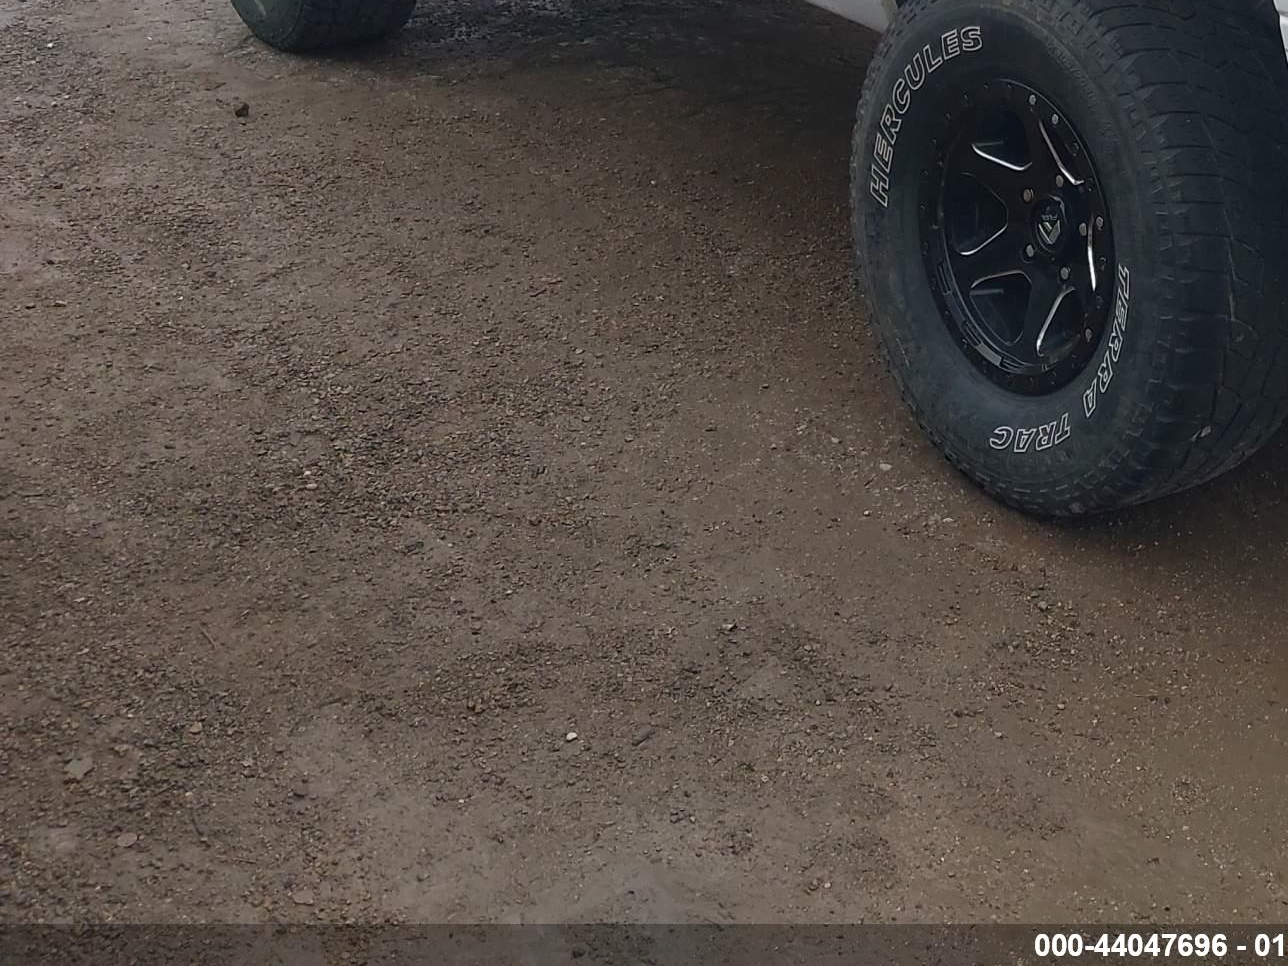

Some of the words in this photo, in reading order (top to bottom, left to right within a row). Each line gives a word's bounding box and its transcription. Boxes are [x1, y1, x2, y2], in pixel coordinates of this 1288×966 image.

[870, 26, 983, 207] HERCULES
[1083, 263, 1130, 418] TERRA
[989, 412, 1071, 453] TRAC
